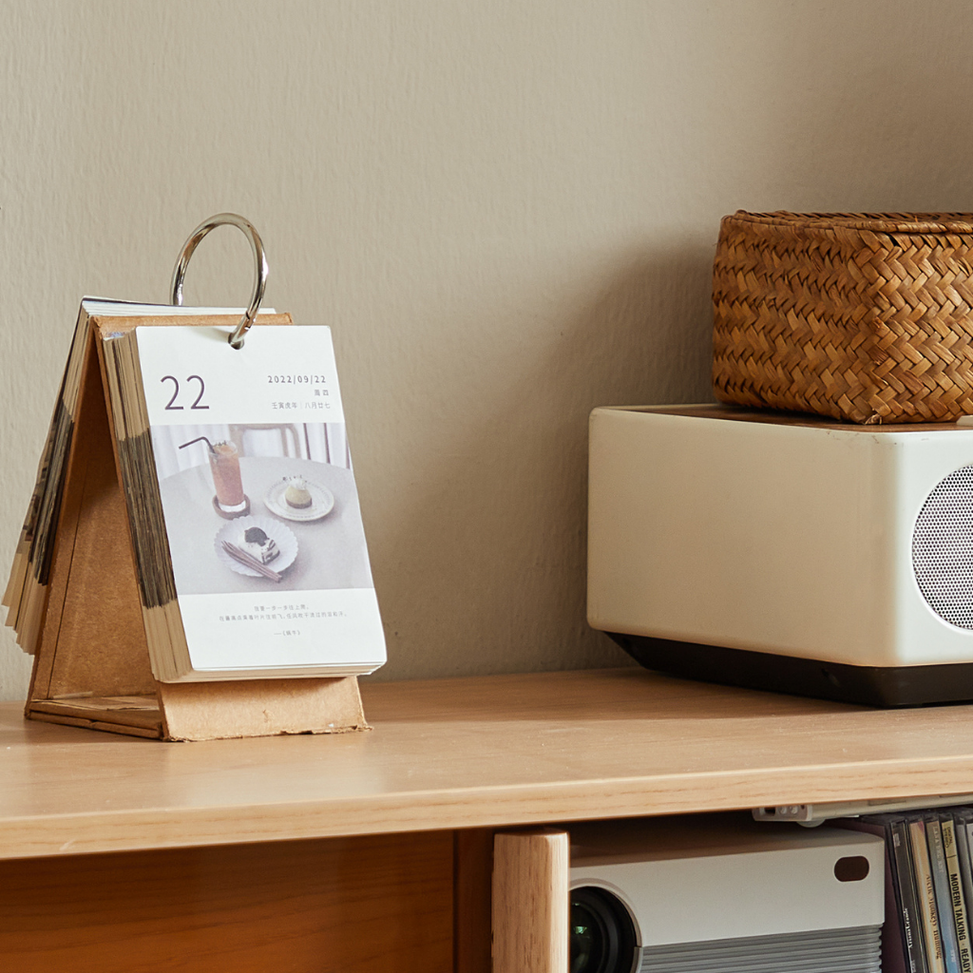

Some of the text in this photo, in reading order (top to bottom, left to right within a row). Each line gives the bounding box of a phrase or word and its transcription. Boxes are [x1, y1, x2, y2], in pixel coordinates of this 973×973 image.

[160, 375, 210, 410] 22
[267, 375, 327, 385] 2022/09/22
[950, 873, 962, 908] MODERN
[955, 908, 966, 944] TALKING
[961, 948, 971, 972] READY
